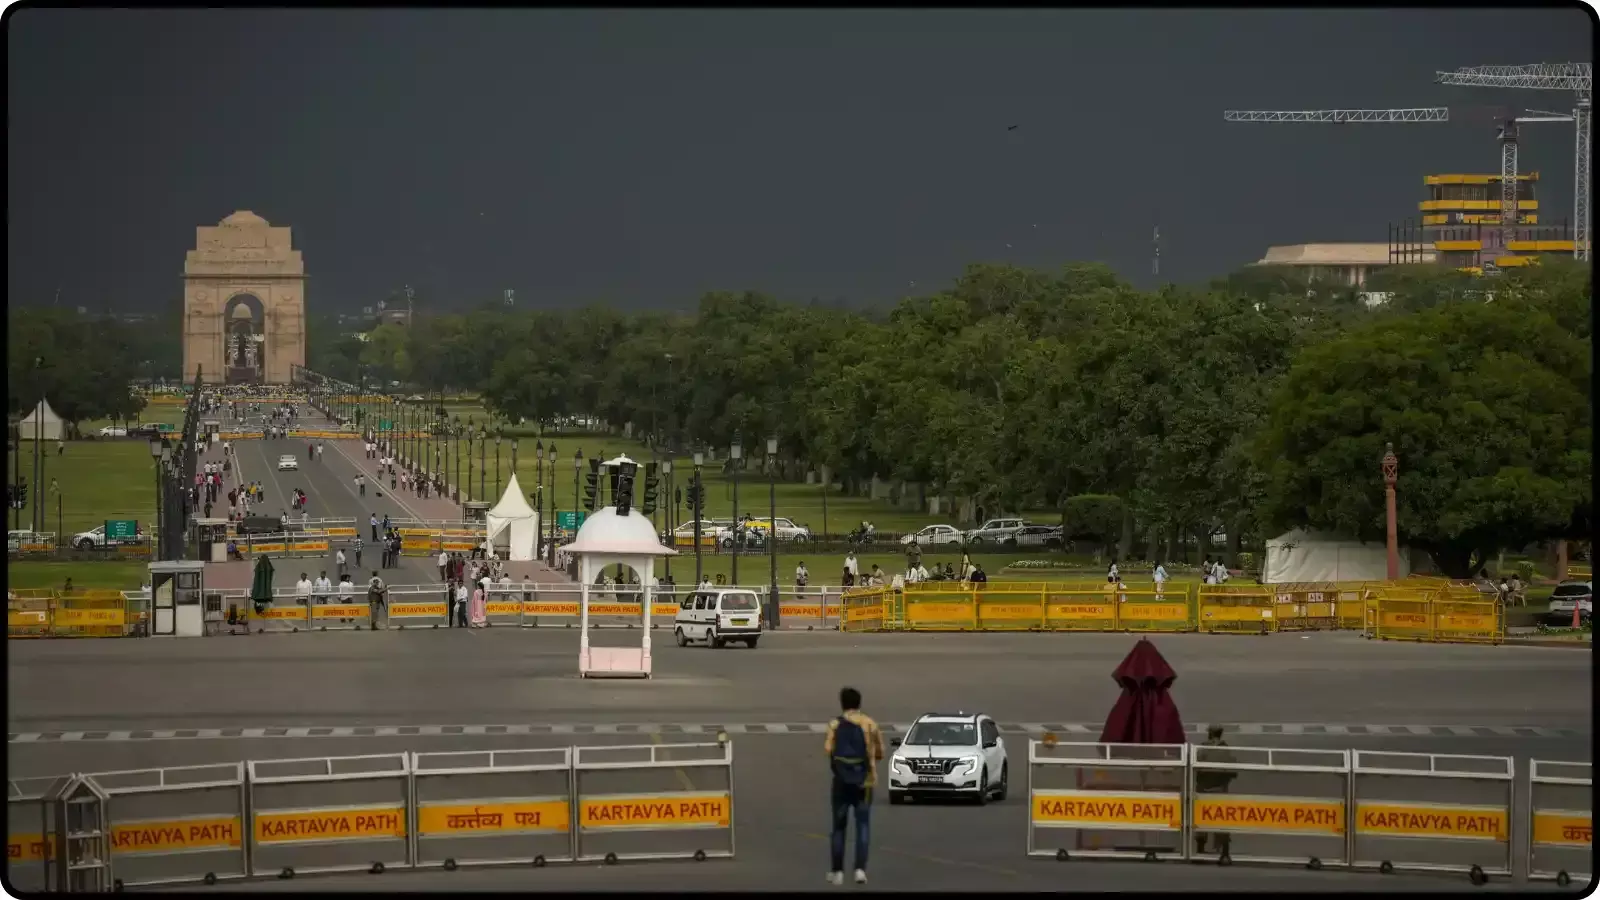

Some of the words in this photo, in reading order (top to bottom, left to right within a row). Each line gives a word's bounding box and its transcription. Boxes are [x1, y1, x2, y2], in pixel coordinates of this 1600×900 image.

[392, 606, 427, 614] KARTAVYA
[486, 603, 514, 613] ARTAVYA
[526, 605, 560, 613] KARTAVYA
[561, 605, 578, 613] PATH
[514, 811, 541, 825] पथ
[588, 803, 675, 821] KARTAVYA
[679, 802, 721, 817] PATH
[1040, 800, 1126, 818] KARTAVYA
[1132, 803, 1174, 820] PATH
[1201, 805, 1289, 823] KARTAVYA
[1294, 808, 1337, 825] PATH
[261, 818, 350, 837] KARTAVYA
[355, 815, 398, 831] PATH
[1364, 811, 1452, 830] KARTAVYA
[1457, 815, 1500, 833] PATH
[111, 828, 185, 848] ARTAVYA
[190, 823, 233, 841] PATH
